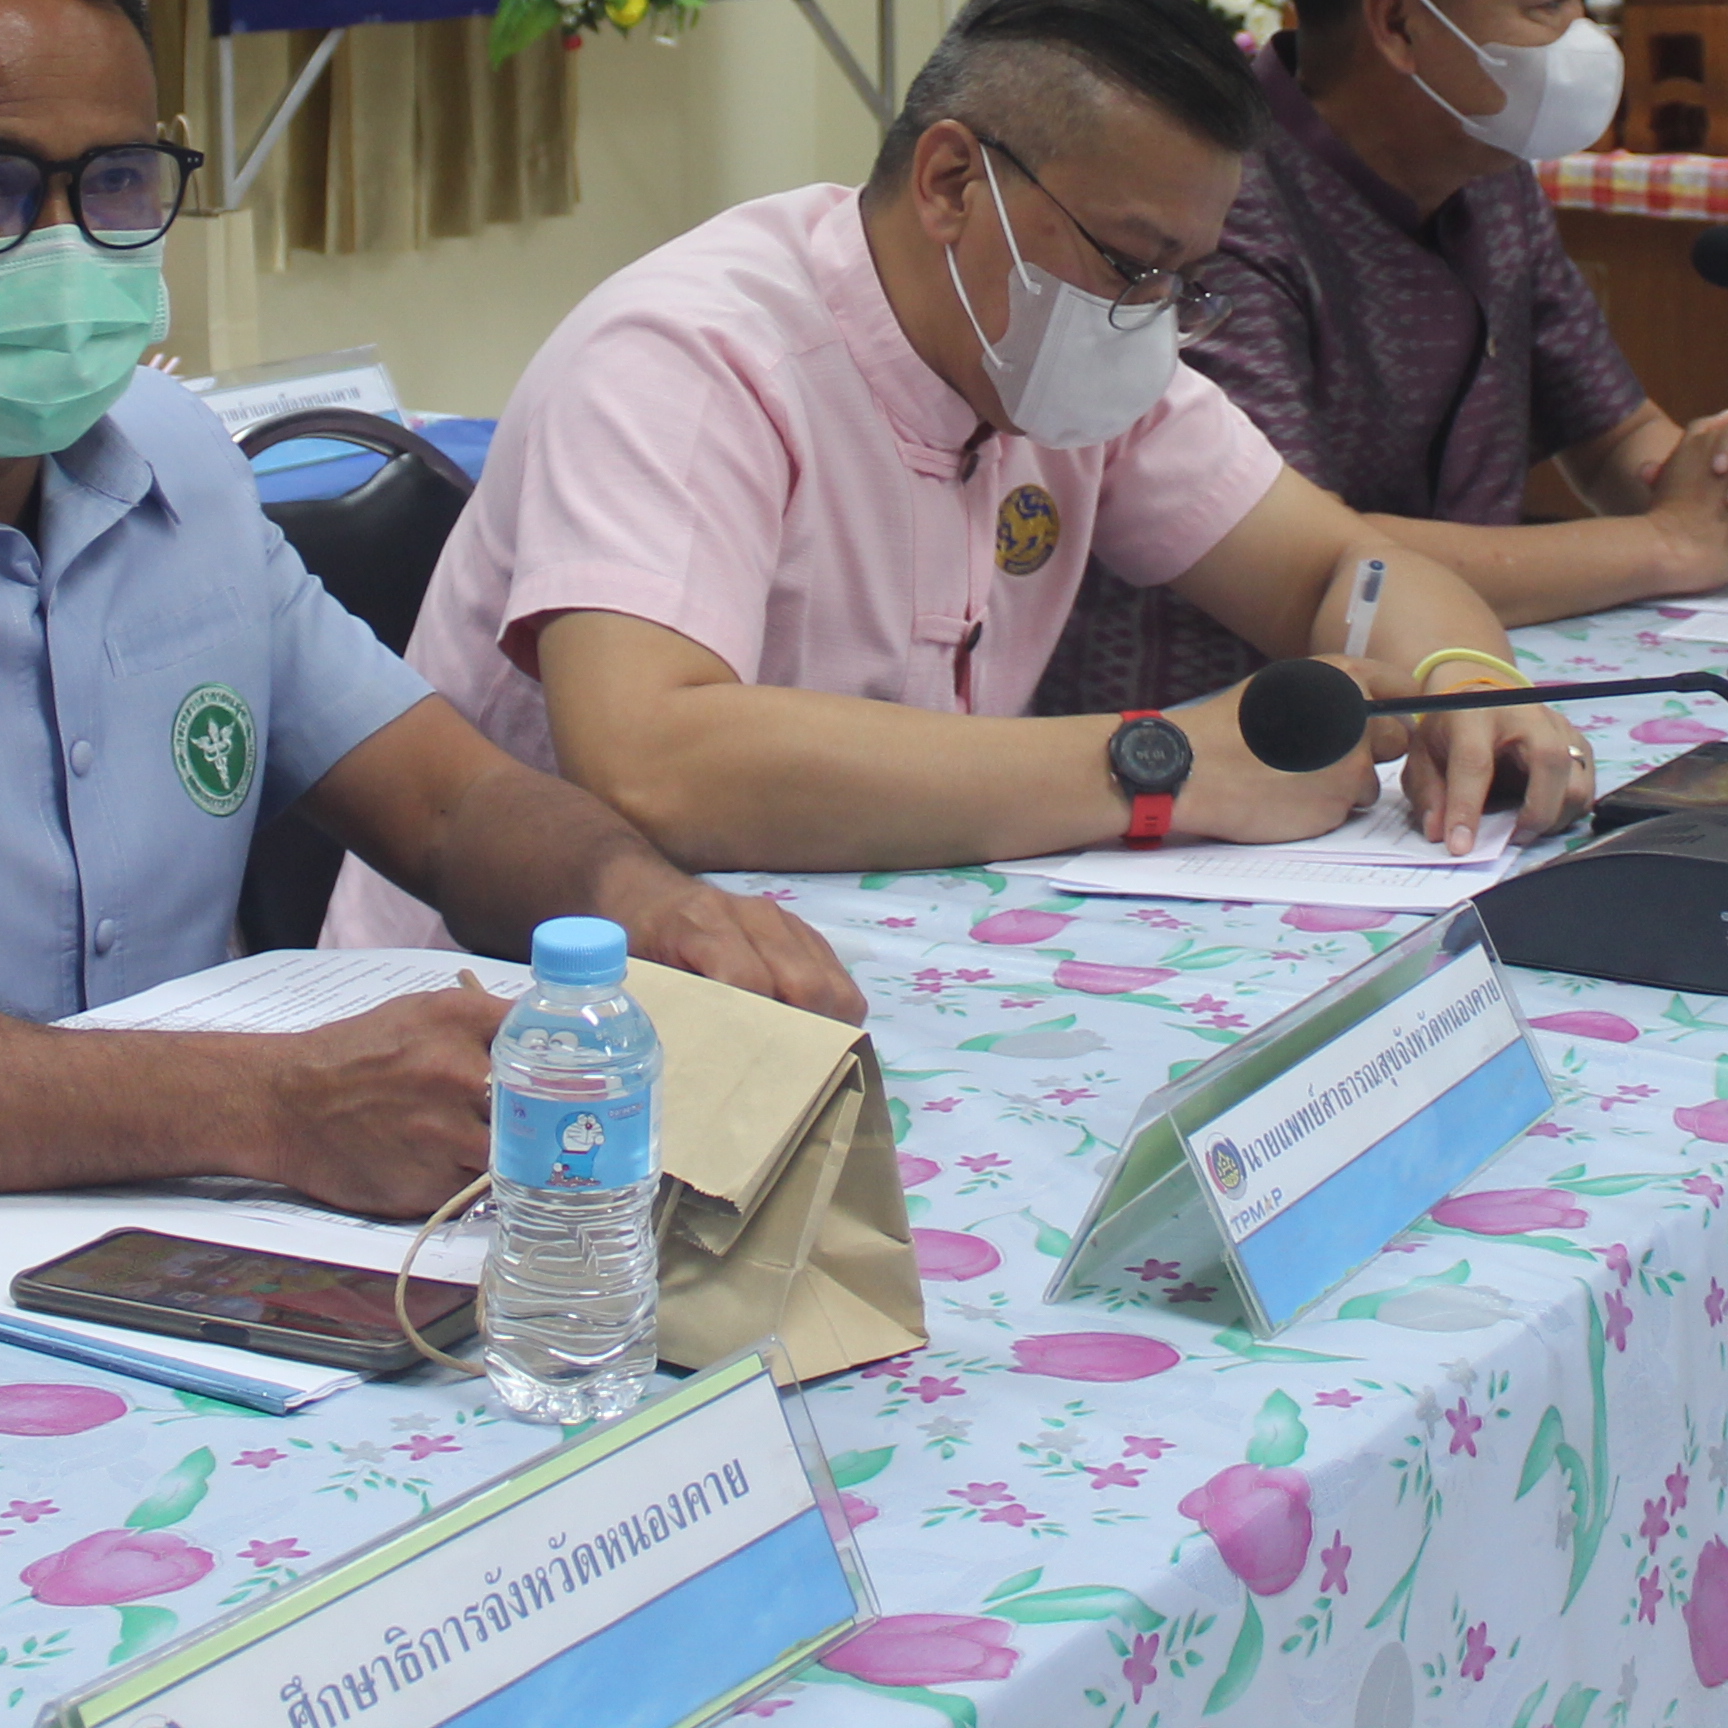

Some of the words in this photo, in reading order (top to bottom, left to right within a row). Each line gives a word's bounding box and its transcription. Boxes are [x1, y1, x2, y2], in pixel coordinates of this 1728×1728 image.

[1242, 975, 1503, 1172] นายแพทย์สาธารณสุขจังหวัดหนองคาย
[280, 1454, 752, 1728] ศึกษาธิการจังหวัดหนองคาย
